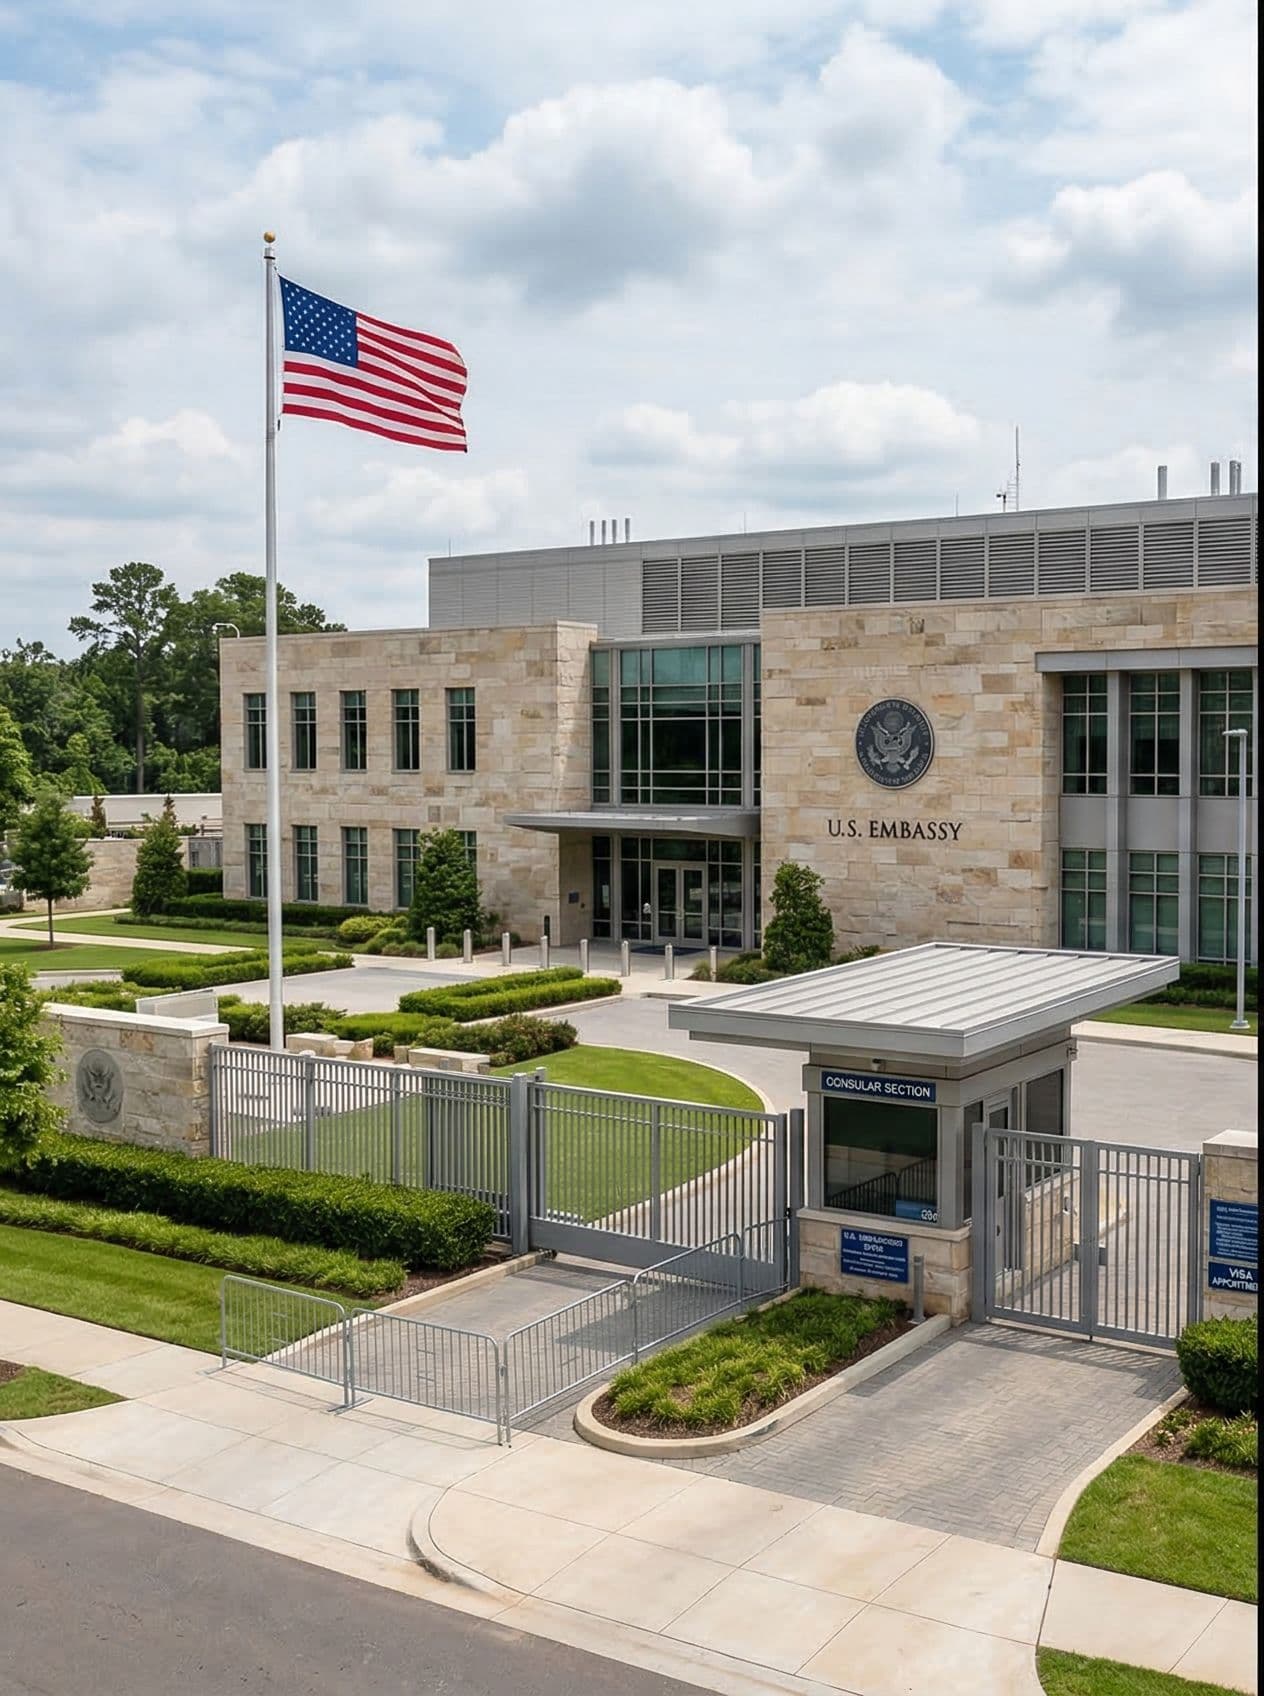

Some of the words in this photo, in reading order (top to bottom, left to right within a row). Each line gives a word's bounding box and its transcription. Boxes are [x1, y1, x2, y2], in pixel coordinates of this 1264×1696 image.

[828, 819, 862, 838] U.S.
[869, 820, 963, 841] EMBASSY
[825, 1076, 882, 1092] CONSULAR
[884, 1082, 931, 1098] SECTION
[1229, 1267, 1253, 1281] VISA
